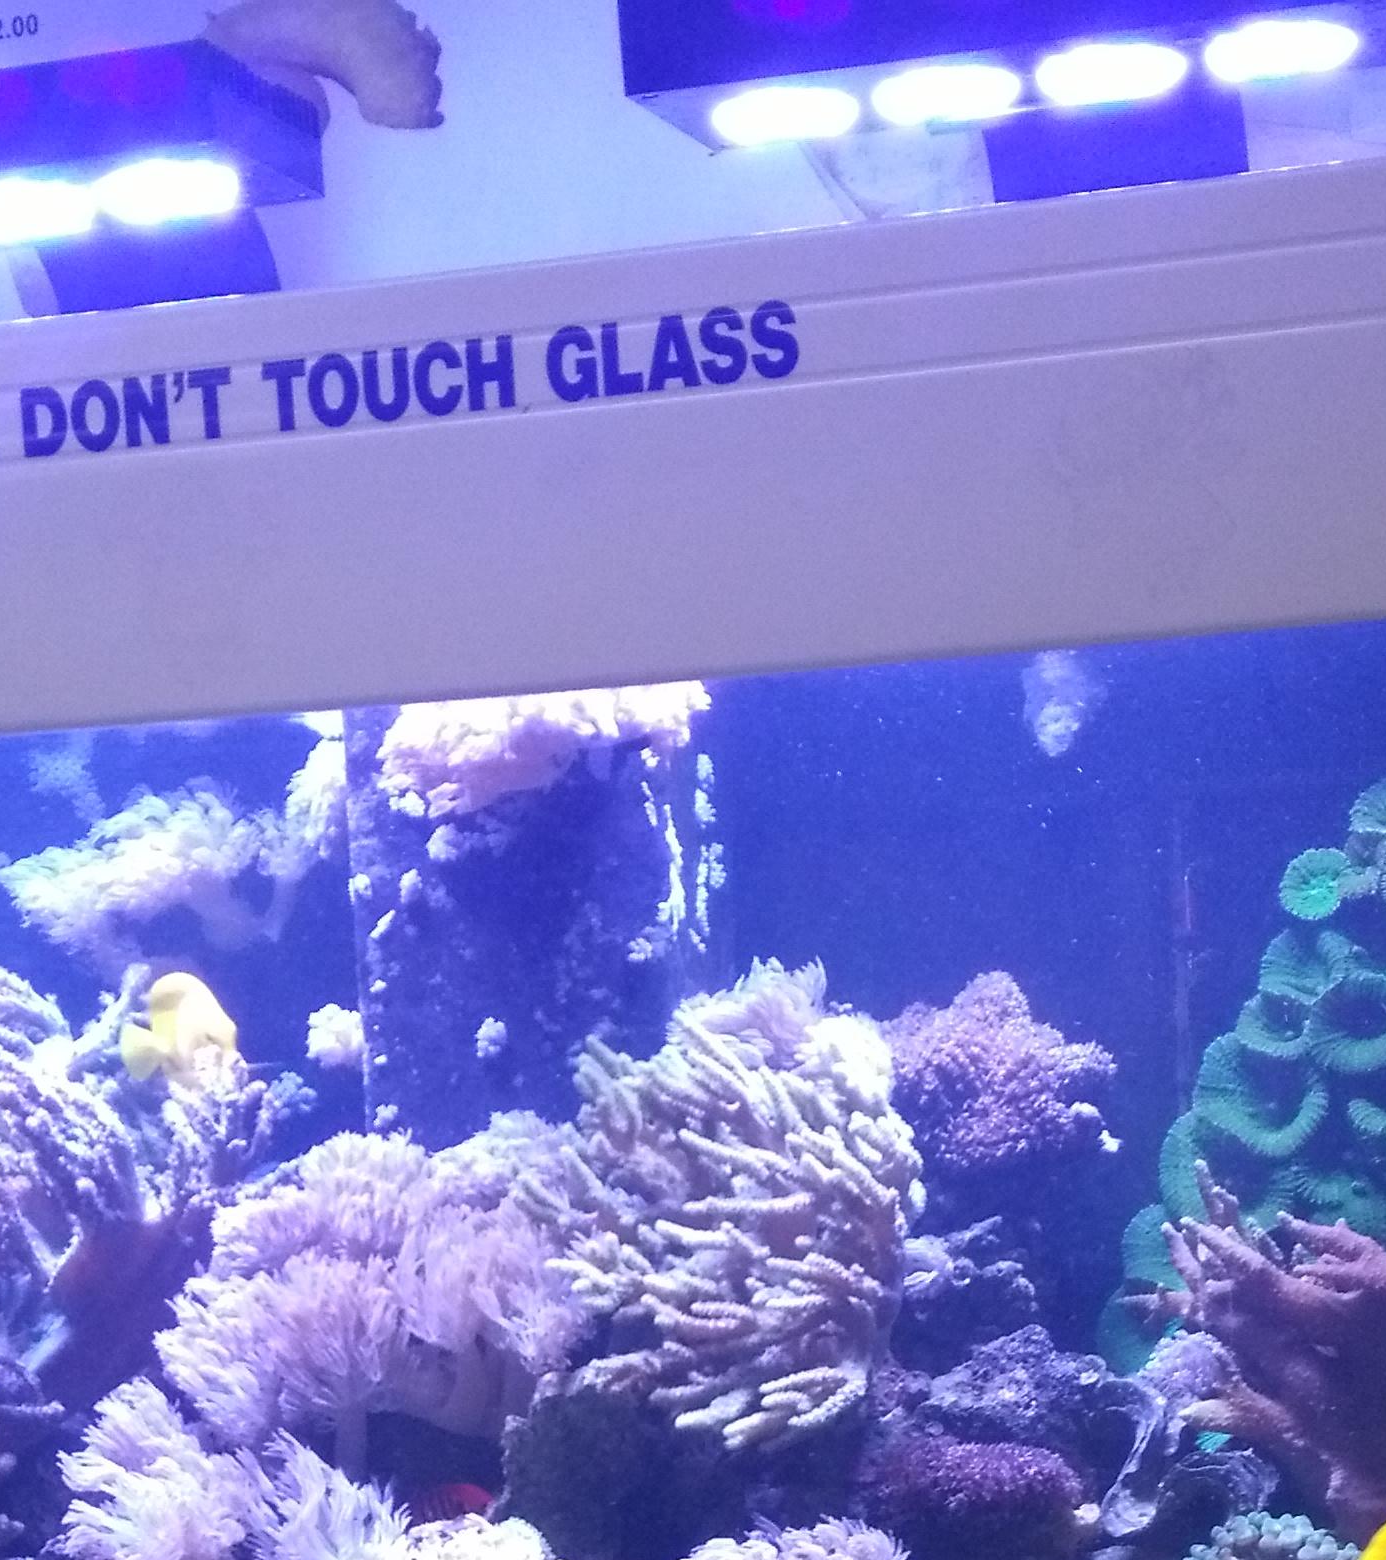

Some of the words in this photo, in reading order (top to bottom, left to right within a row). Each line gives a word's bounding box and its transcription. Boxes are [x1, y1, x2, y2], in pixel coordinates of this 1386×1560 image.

[19, 366, 232, 459] DON'T
[261, 334, 517, 432] TOUCH
[545, 300, 801, 402] GLASS
